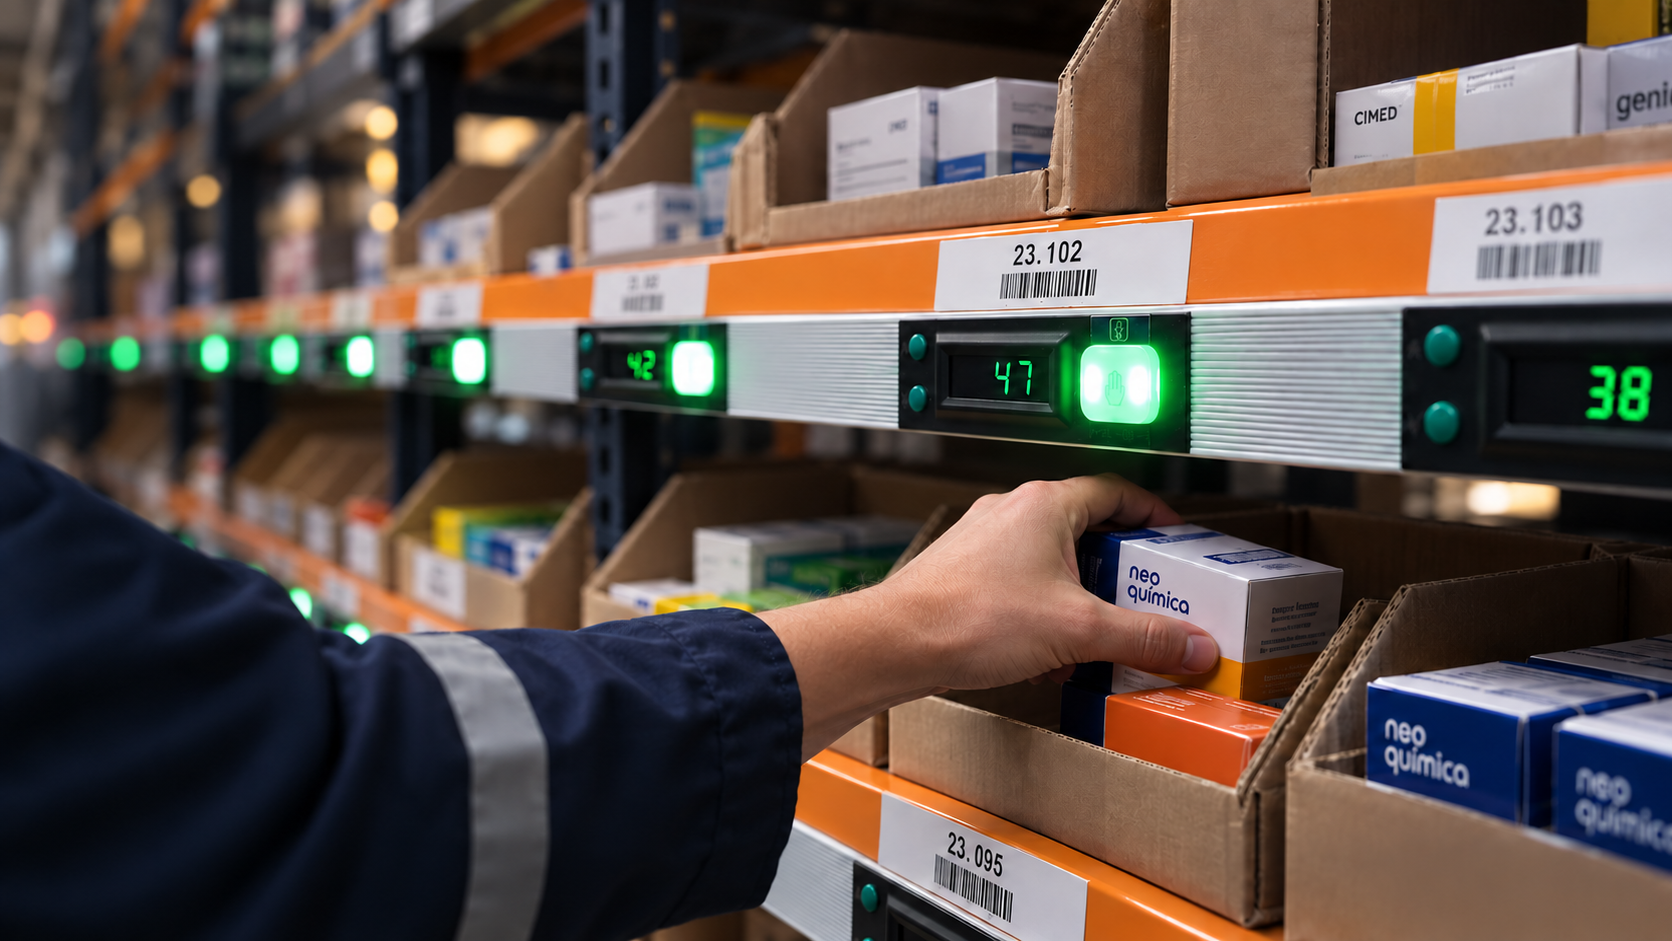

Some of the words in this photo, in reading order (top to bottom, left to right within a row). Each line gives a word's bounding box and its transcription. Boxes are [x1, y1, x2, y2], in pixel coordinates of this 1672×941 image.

[1354, 105, 1398, 126] CIMED
[1616, 81, 1672, 122] geni
[1485, 202, 1583, 236] 23.103
[1012, 239, 1083, 266] 23.102
[627, 350, 656, 381] 42
[994, 360, 1034, 396] 47
[1586, 365, 1652, 422] 38
[1129, 565, 1161, 586] neo
[1127, 584, 1190, 616] química
[1384, 718, 1427, 748] neo
[1384, 745, 1470, 789] química
[1576, 767, 1631, 807] neo
[947, 831, 1004, 878] 23.095
